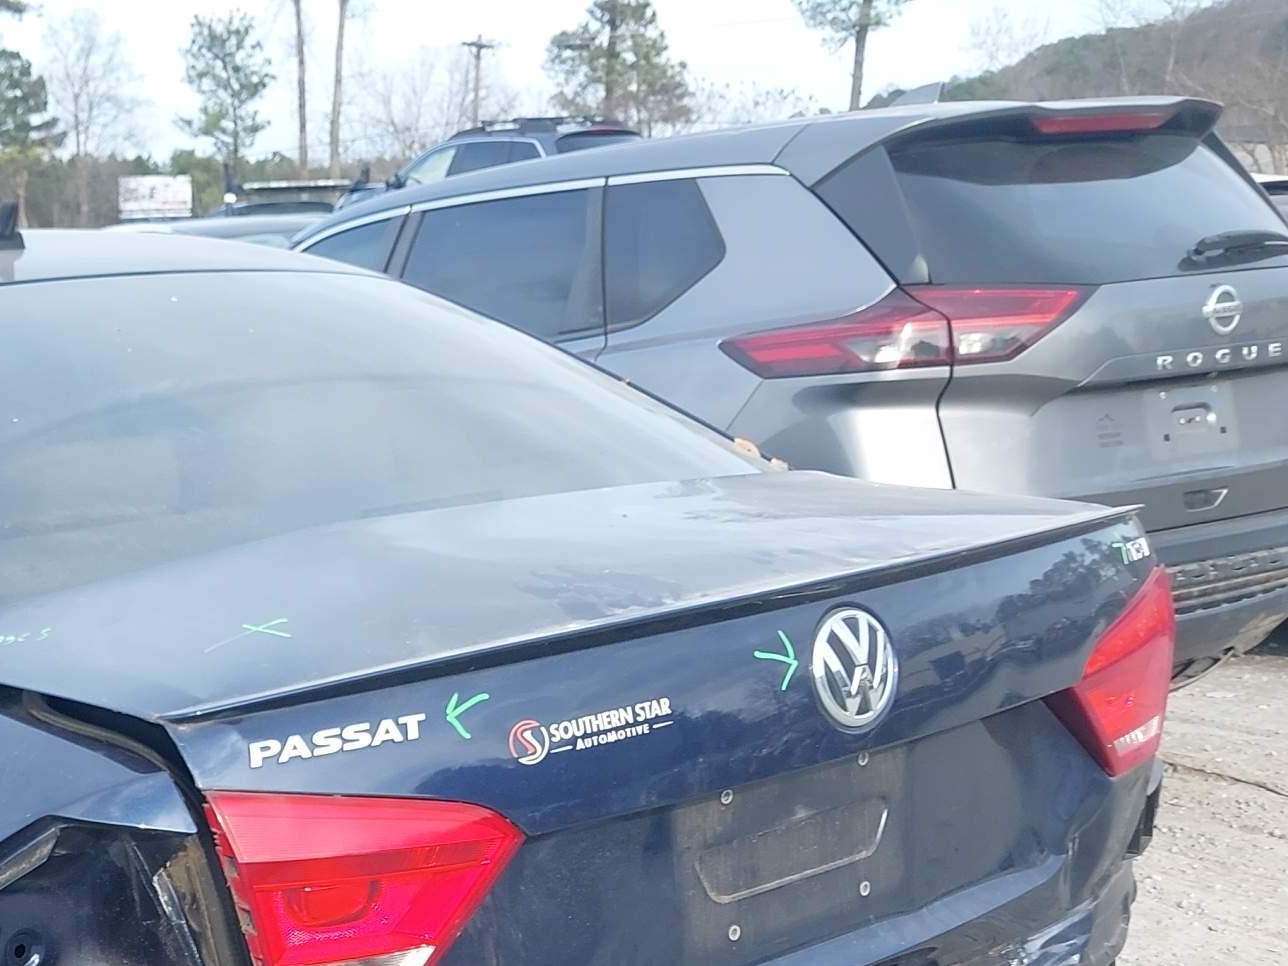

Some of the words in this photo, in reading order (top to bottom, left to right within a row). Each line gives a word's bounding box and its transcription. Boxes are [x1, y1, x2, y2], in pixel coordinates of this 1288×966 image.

[1156, 342, 1282, 370] ROGUE
[549, 705, 634, 743] SOUTHERN
[634, 697, 672, 722] STAR
[575, 723, 650, 751] AUTOMOTIVE
[248, 713, 427, 769] PASSAT
